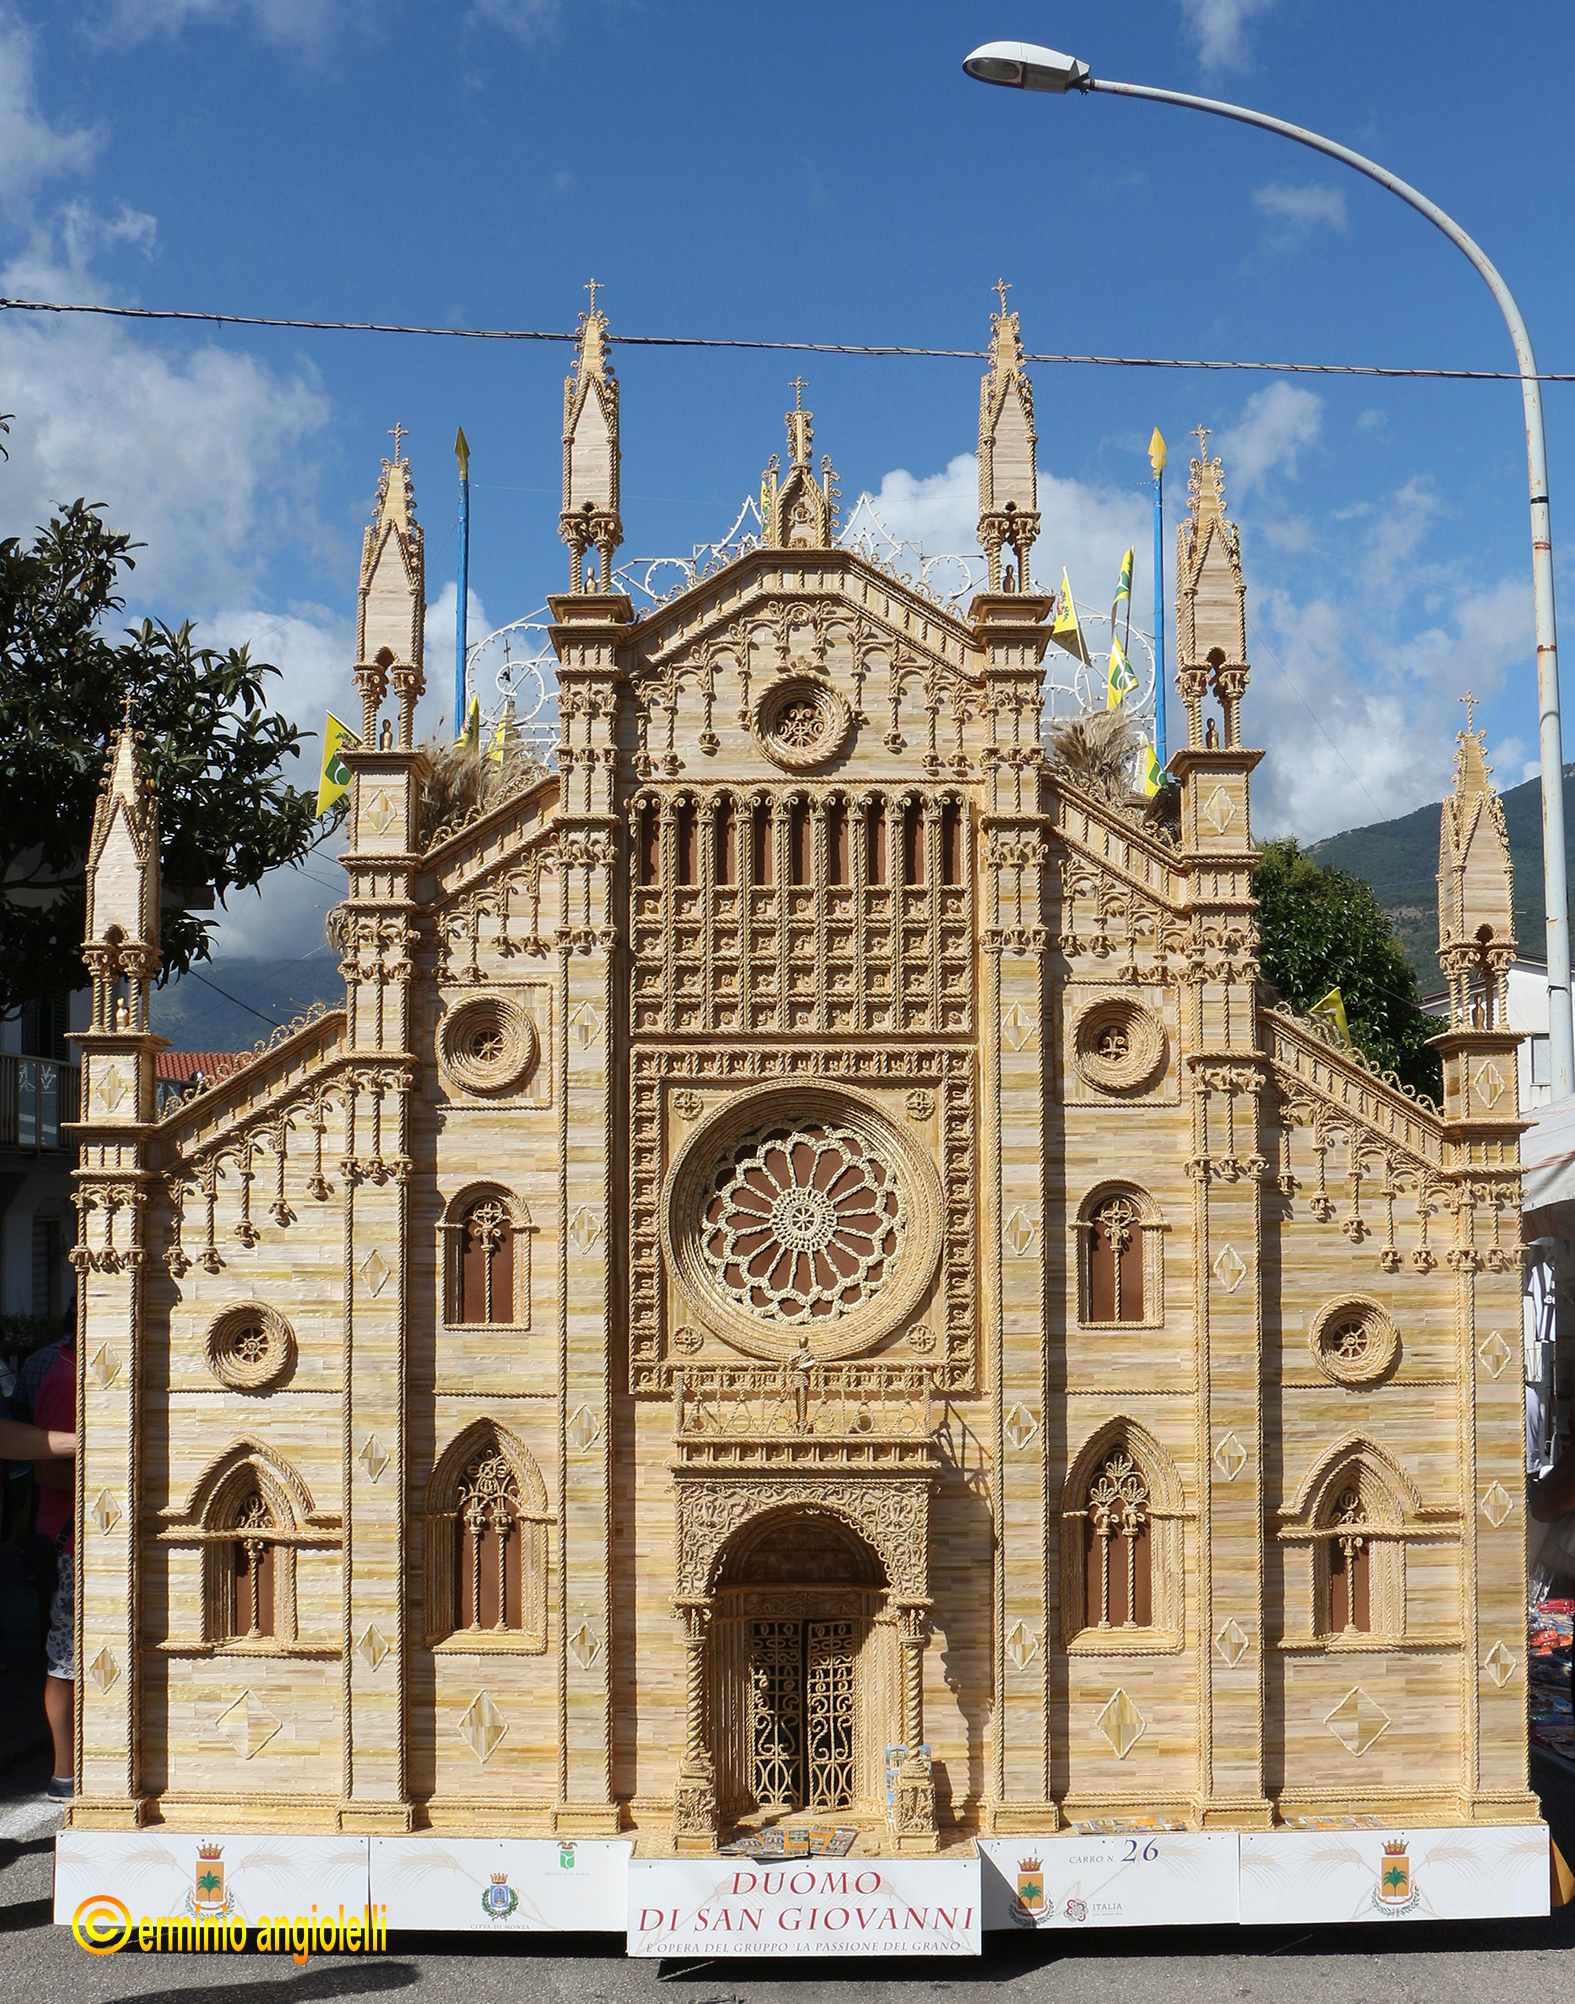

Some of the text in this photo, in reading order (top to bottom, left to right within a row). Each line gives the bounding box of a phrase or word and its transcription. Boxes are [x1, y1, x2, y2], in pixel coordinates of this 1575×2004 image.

[1069, 1838, 1159, 1864] CARRO N. 26
[730, 1872, 883, 1896] DUOMO
[637, 1906, 976, 1933] DI SAN GIOVANNI
[646, 1942, 653, 1952] È
[657, 1943, 700, 1953] OPERA
[705, 1943, 729, 1953] DEL
[733, 1942, 788, 1953] GRUPPO
[815, 1942, 878, 1952] PASSIONE
[883, 1941, 907, 1951] DEL
